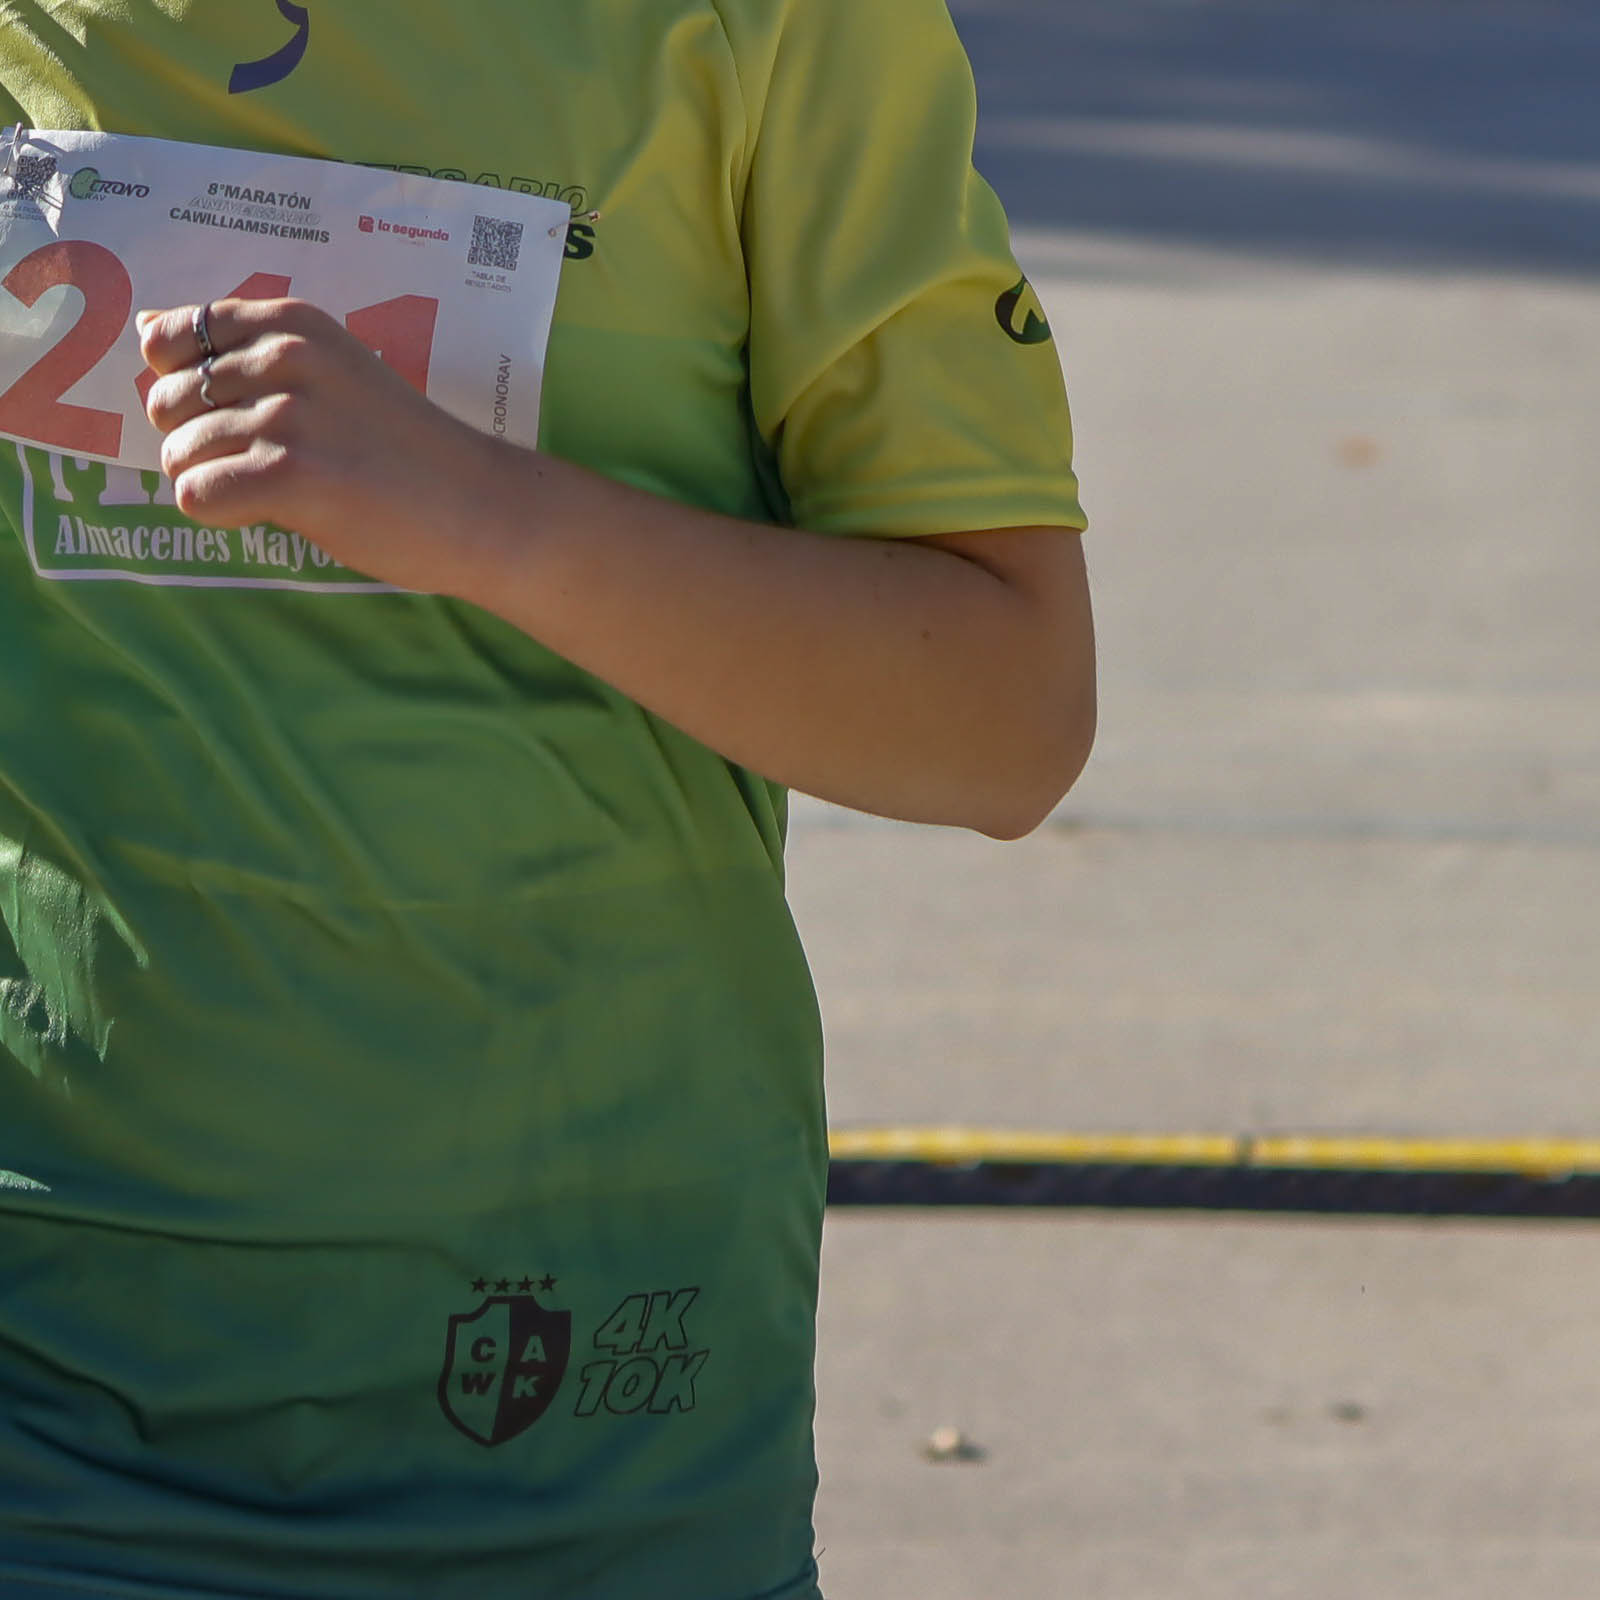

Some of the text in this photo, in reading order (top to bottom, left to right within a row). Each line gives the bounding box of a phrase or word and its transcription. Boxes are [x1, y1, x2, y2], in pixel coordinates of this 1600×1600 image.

[169, 207, 330, 243] CAWILLIAMSKEMMIS
[392, 224, 449, 241] segunda
[53, 515, 231, 563] Almacenes
[594, 1287, 700, 1355] 4K
[471, 1335, 547, 1363] C A
[461, 1373, 544, 1399] W K
[574, 1349, 710, 1417] 10K
